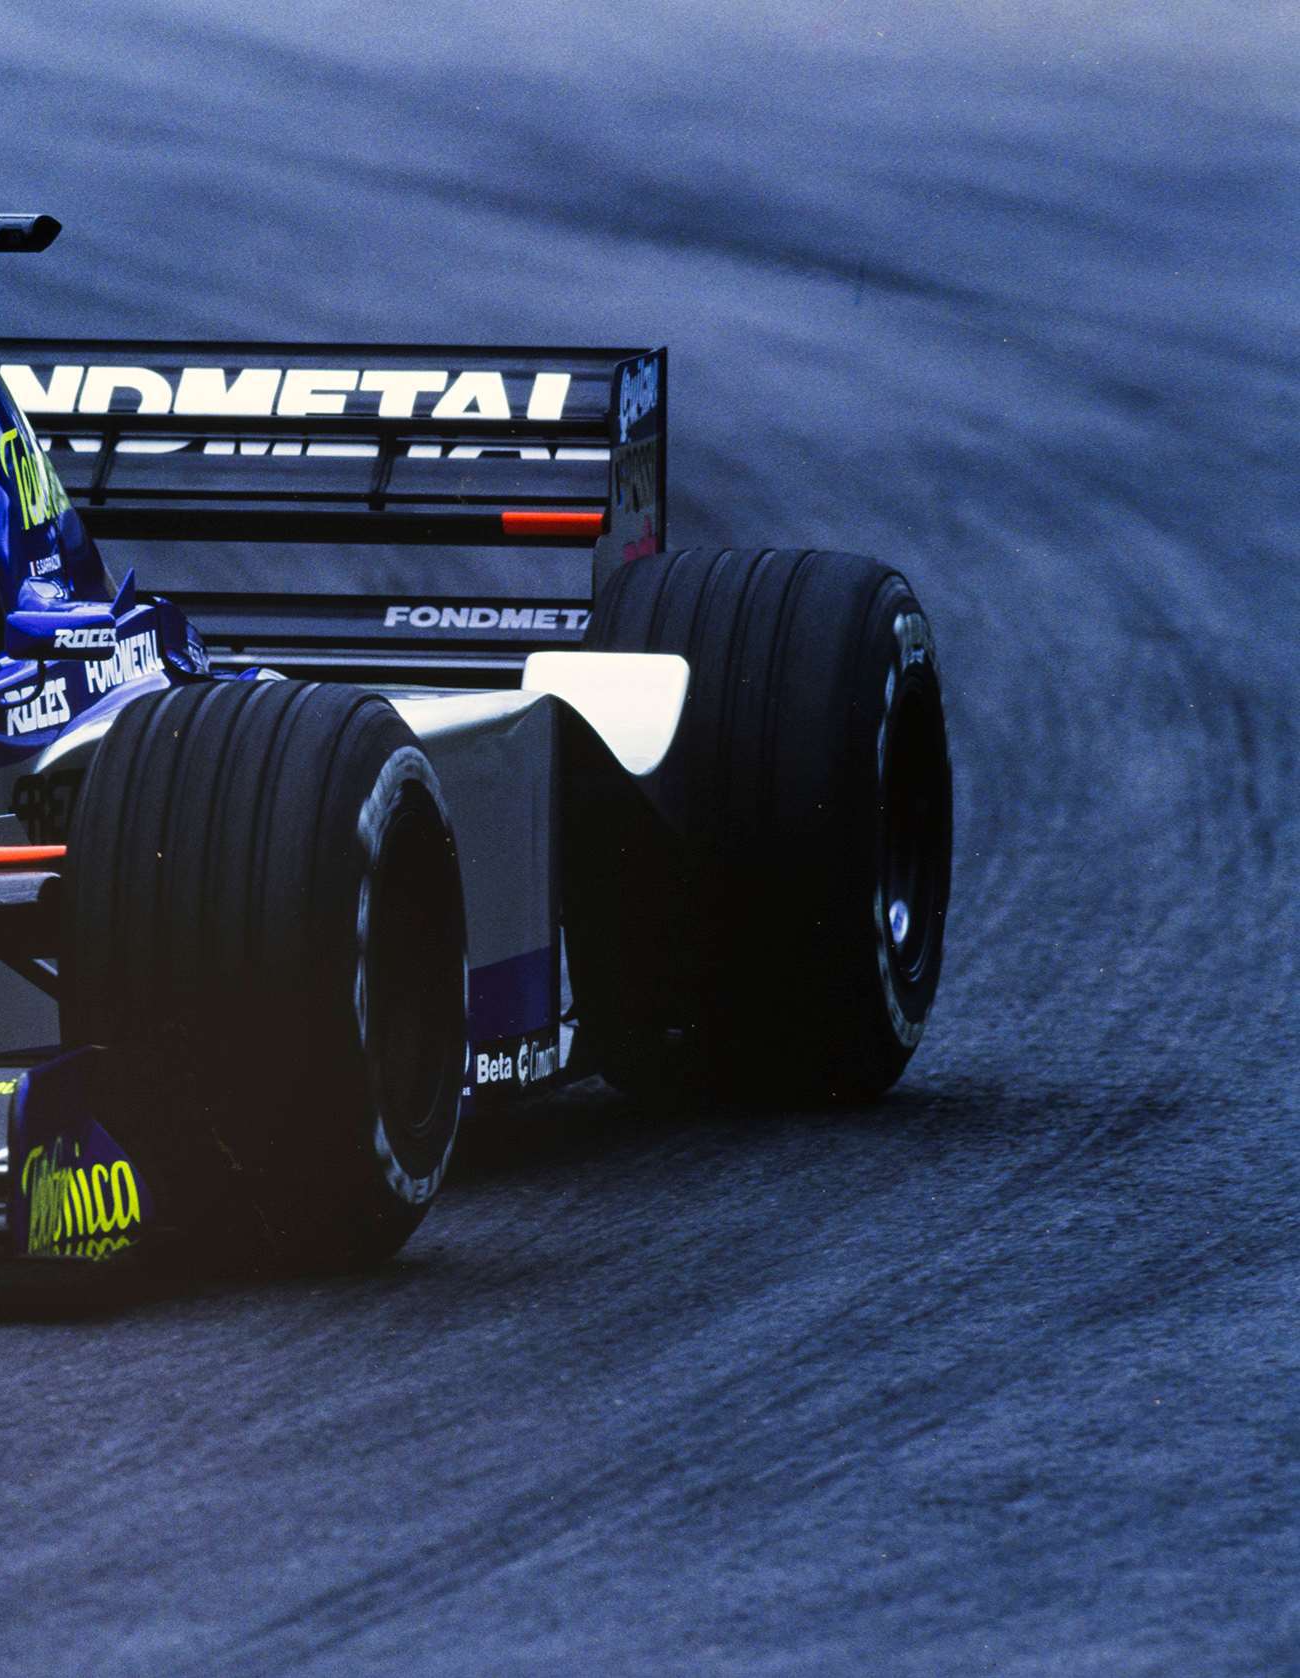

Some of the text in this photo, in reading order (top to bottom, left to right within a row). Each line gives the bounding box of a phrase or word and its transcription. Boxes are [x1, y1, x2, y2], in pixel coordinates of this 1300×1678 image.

[383, 606, 593, 630] FONDMET
[54, 628, 117, 649] ROCES
[476, 1052, 513, 1084] Beta
